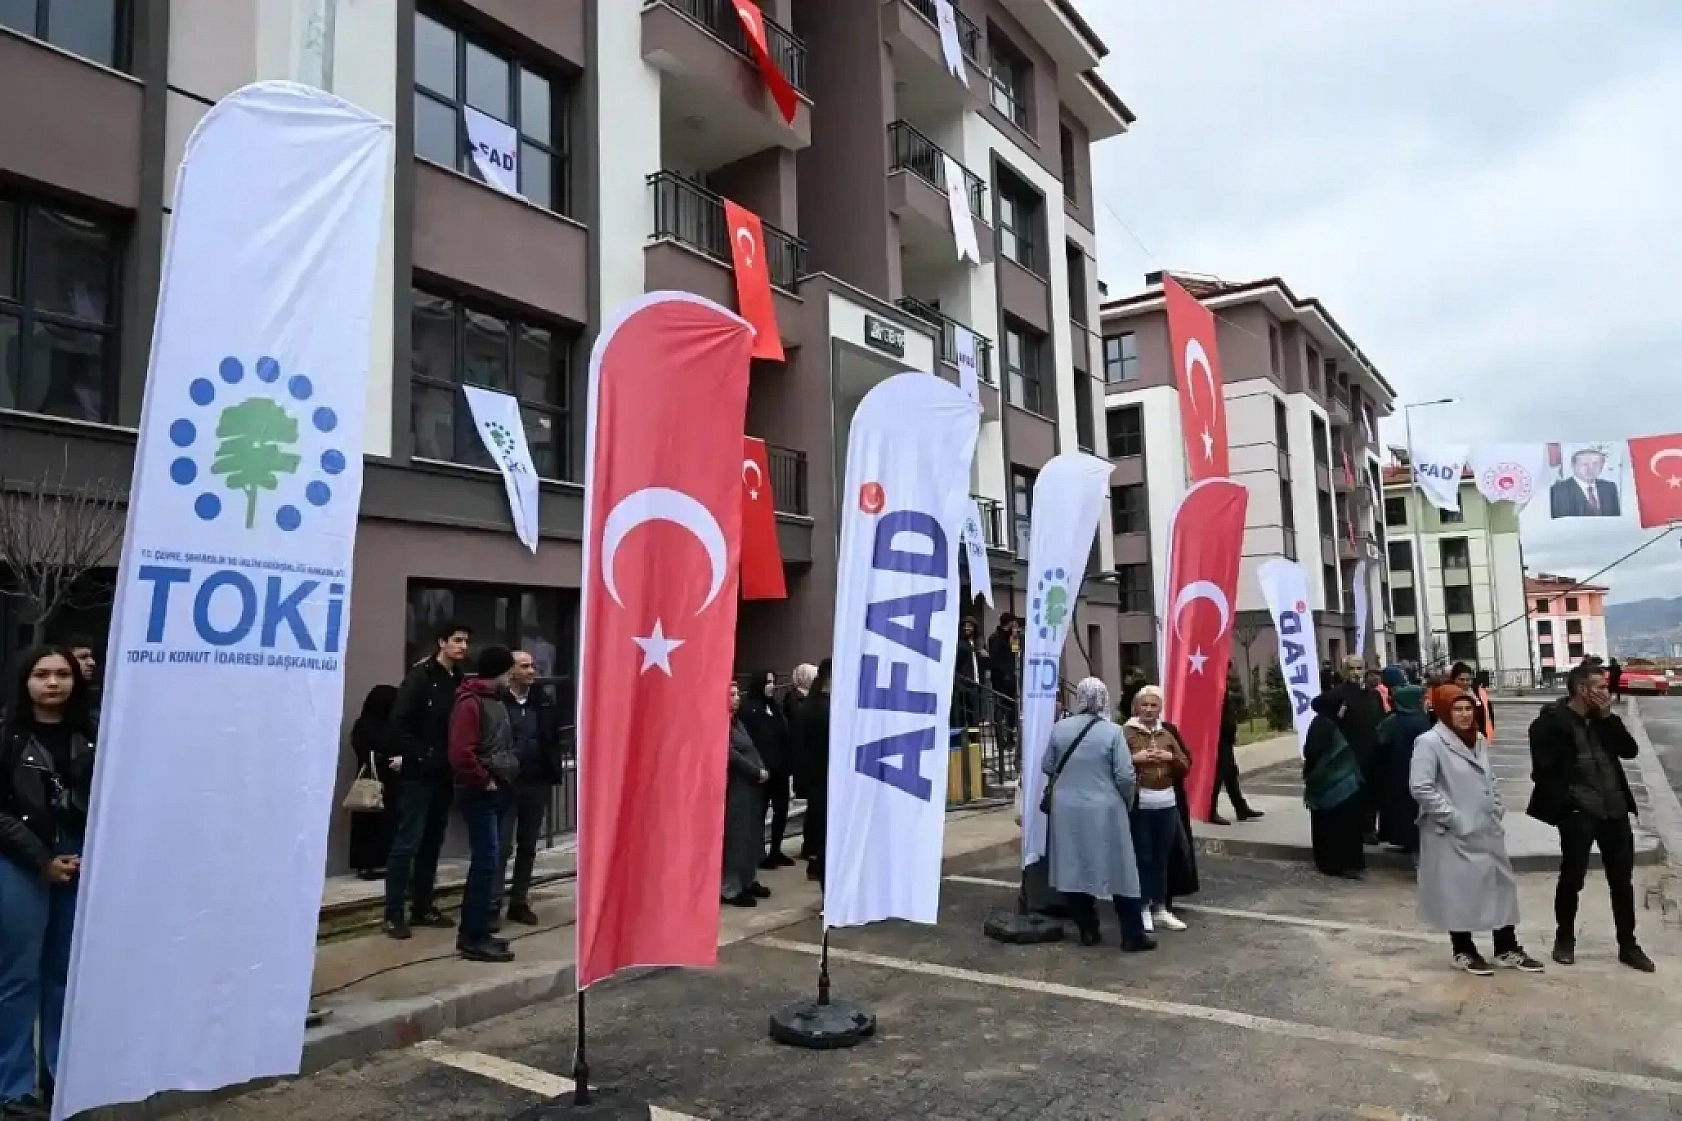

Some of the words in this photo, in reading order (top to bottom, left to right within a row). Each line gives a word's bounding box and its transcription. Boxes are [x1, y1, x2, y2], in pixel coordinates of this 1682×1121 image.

[138, 565, 345, 653] TOKİ
[169, 651, 211, 663] KONUT
[214, 649, 264, 666] İDARESİ
[267, 654, 338, 671] BAŞKANLIĞI
[855, 509, 948, 802] AFAD
